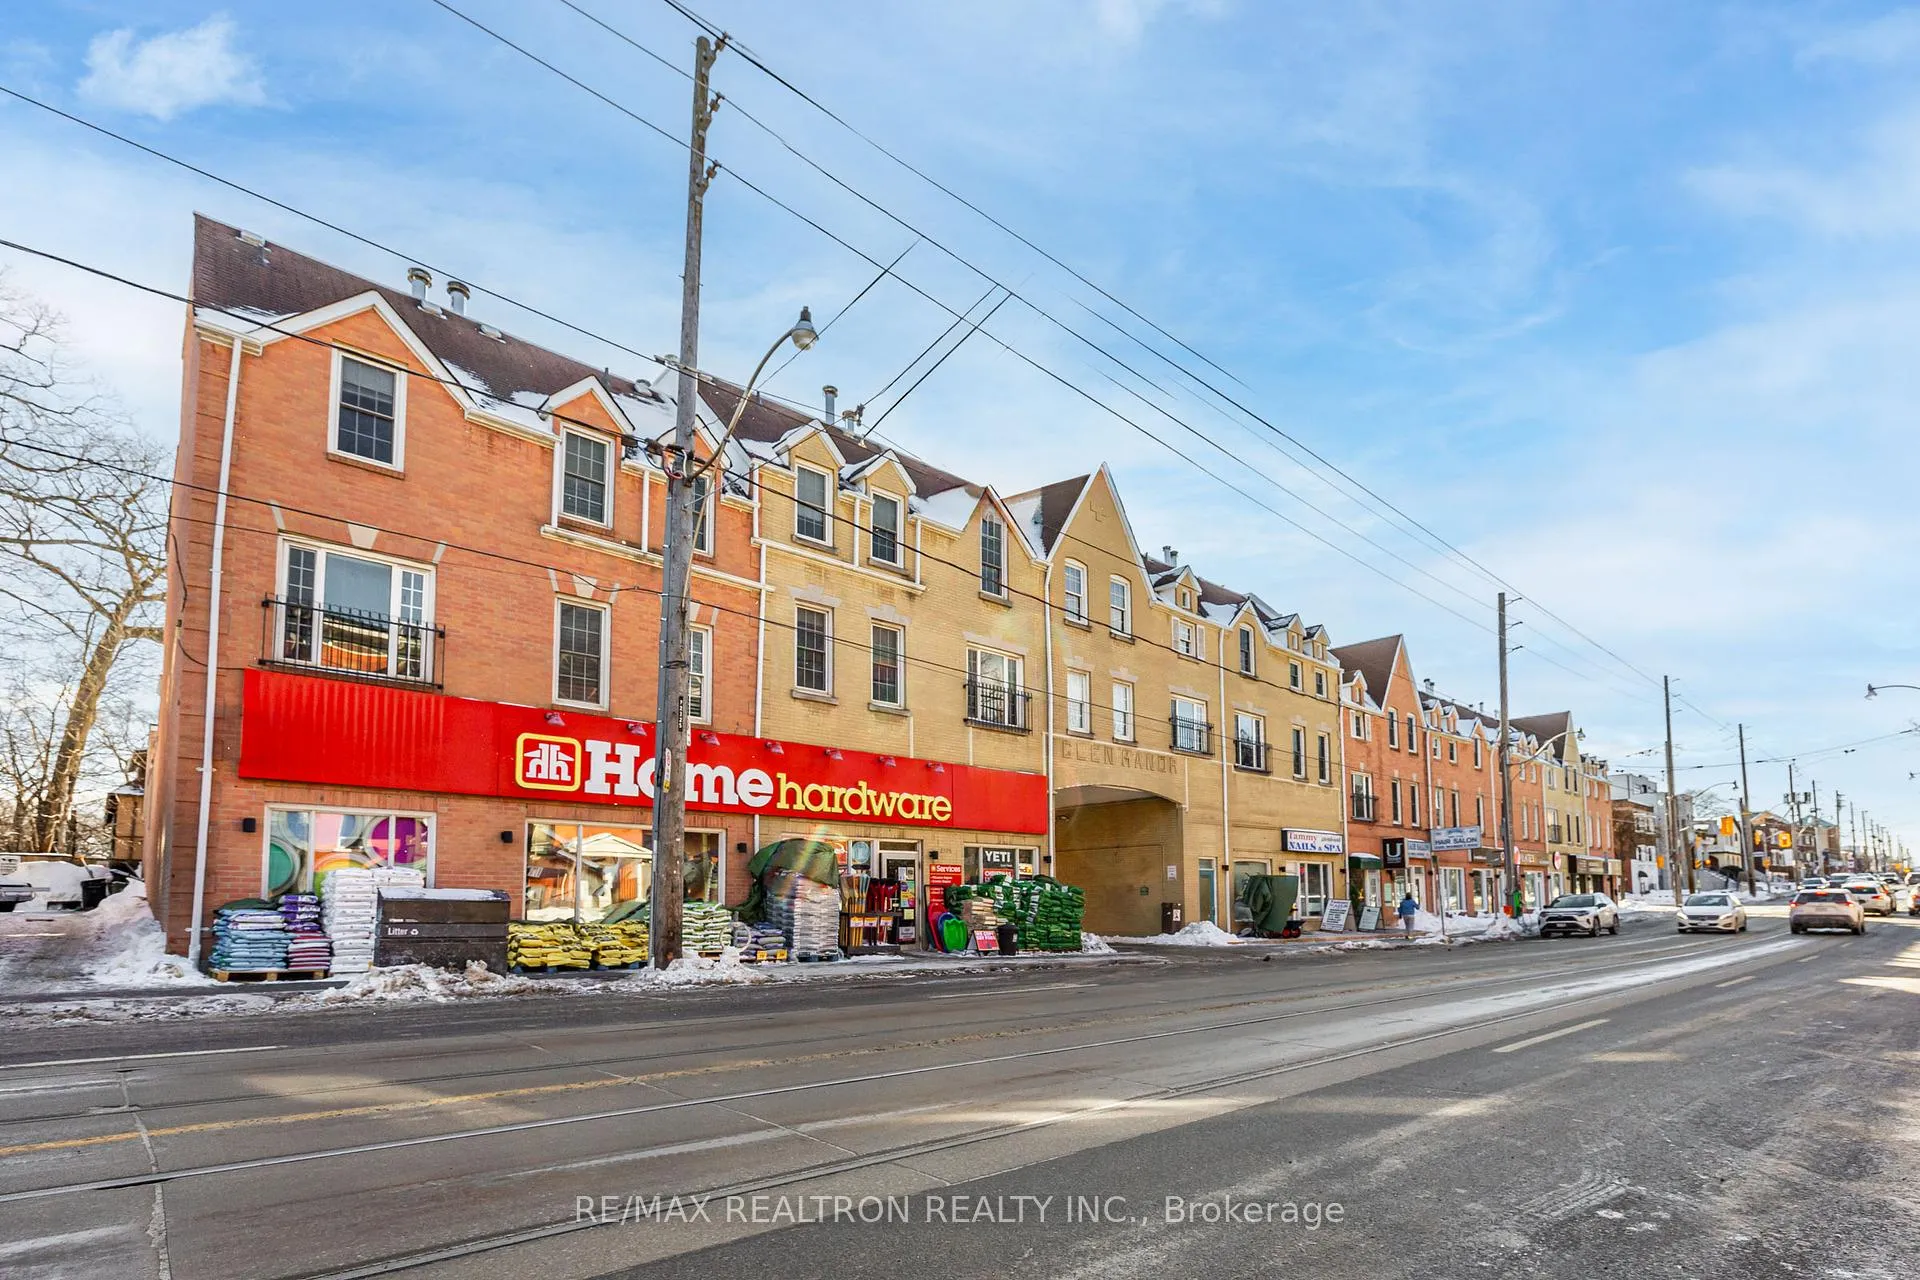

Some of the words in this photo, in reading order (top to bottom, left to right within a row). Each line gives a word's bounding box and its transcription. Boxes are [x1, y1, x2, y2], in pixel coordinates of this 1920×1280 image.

[1062, 739, 1114, 766] GLEN
[776, 772, 952, 821] hardware
[1289, 841, 1317, 850] NAILS
[1323, 843, 1342, 852] SPA
[1453, 837, 1478, 845] SALON
[1386, 843, 1403, 857] U
[985, 850, 1011, 863] YETI
[936, 865, 961, 873] Services
[387, 927, 408, 936] Litter
